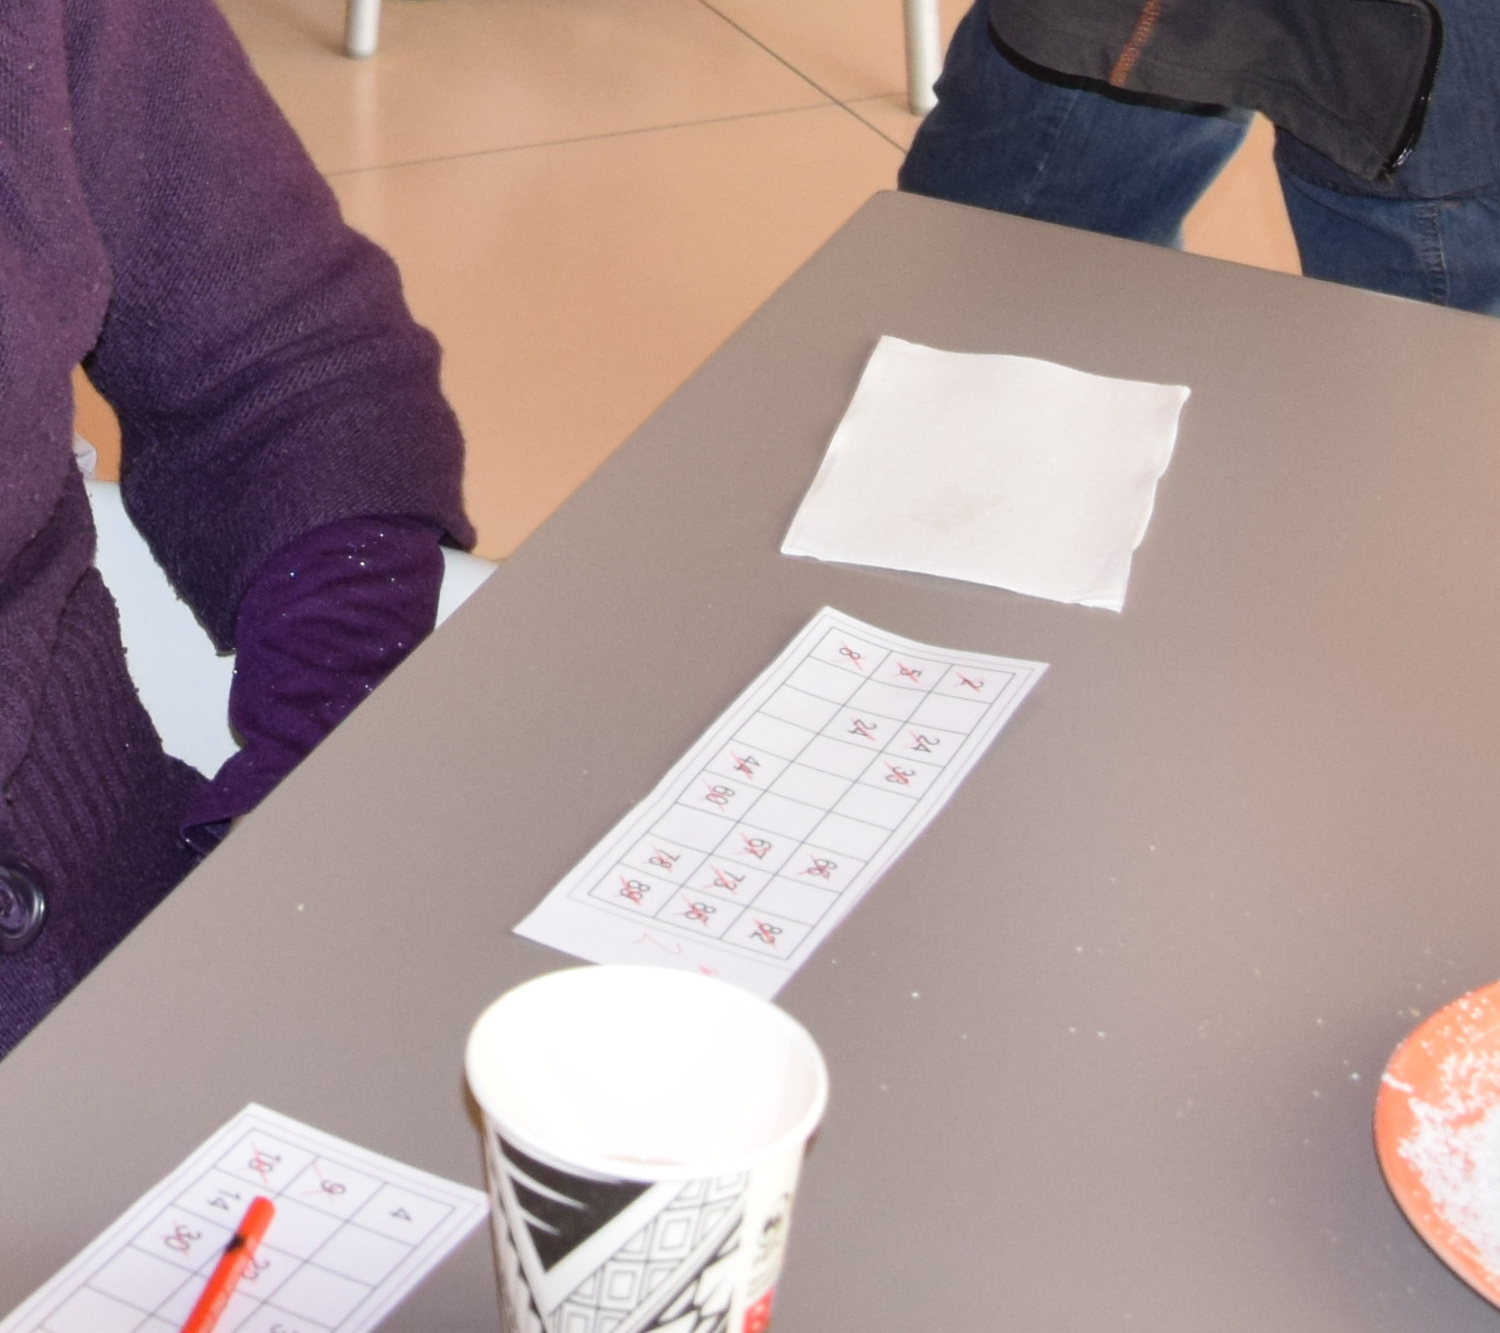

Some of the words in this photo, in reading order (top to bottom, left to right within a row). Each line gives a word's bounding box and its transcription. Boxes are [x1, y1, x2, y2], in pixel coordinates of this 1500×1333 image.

[838, 646, 861, 659] 8
[897, 666, 920, 682] 5
[960, 678, 984, 691] 2
[847, 718, 878, 738] 24
[911, 734, 941, 754] 24
[732, 755, 761, 775] 44
[705, 785, 736, 805] 60
[648, 848, 681, 869] 78
[744, 838, 773, 861] 67
[619, 880, 651, 901] 89
[749, 923, 783, 945] 82
[248, 1152, 282, 1173] 10
[321, 1180, 347, 1195] 9
[207, 1189, 241, 1211] 14
[388, 1207, 412, 1222] 4
[163, 1225, 203, 1252] 30
